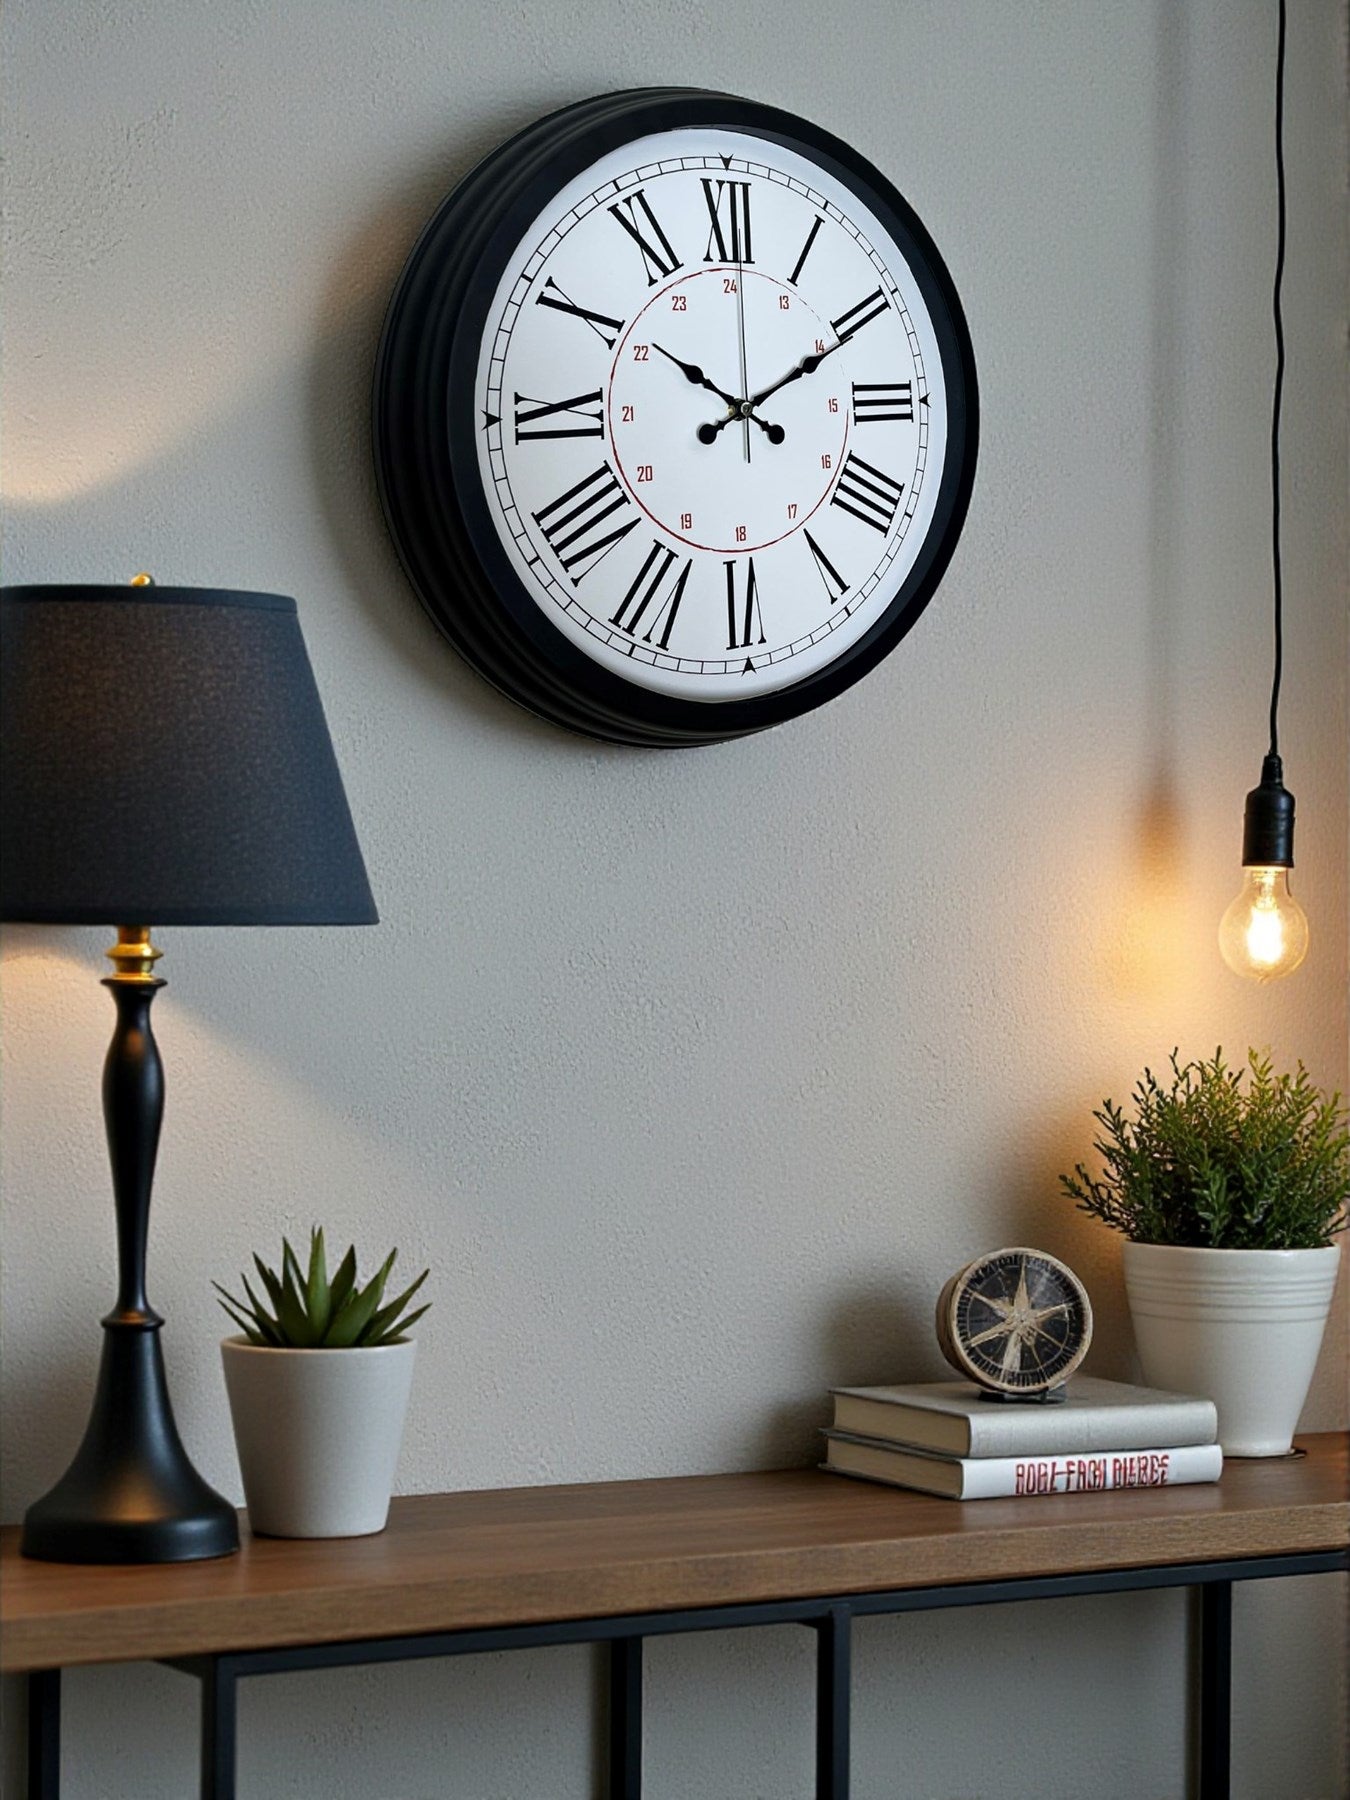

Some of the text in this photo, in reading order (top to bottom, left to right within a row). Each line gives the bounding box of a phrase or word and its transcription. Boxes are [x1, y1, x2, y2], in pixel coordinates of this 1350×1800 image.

[607, 189, 684, 287] XI
[724, 279, 737, 294] 24
[672, 296, 687, 312] 23
[779, 295, 789, 310] 13
[536, 276, 625, 350] X
[830, 285, 891, 342] II
[633, 345, 648, 362] 22
[815, 339, 825, 353] 14
[829, 399, 838, 412] 15
[852, 380, 914, 426] III
[622, 406, 634, 422] 21
[821, 455, 831, 469] 16
[637, 466, 653, 483] 20
[788, 504, 798, 519] 17
[681, 513, 692, 530] 19
[736, 526, 746, 542] 18
